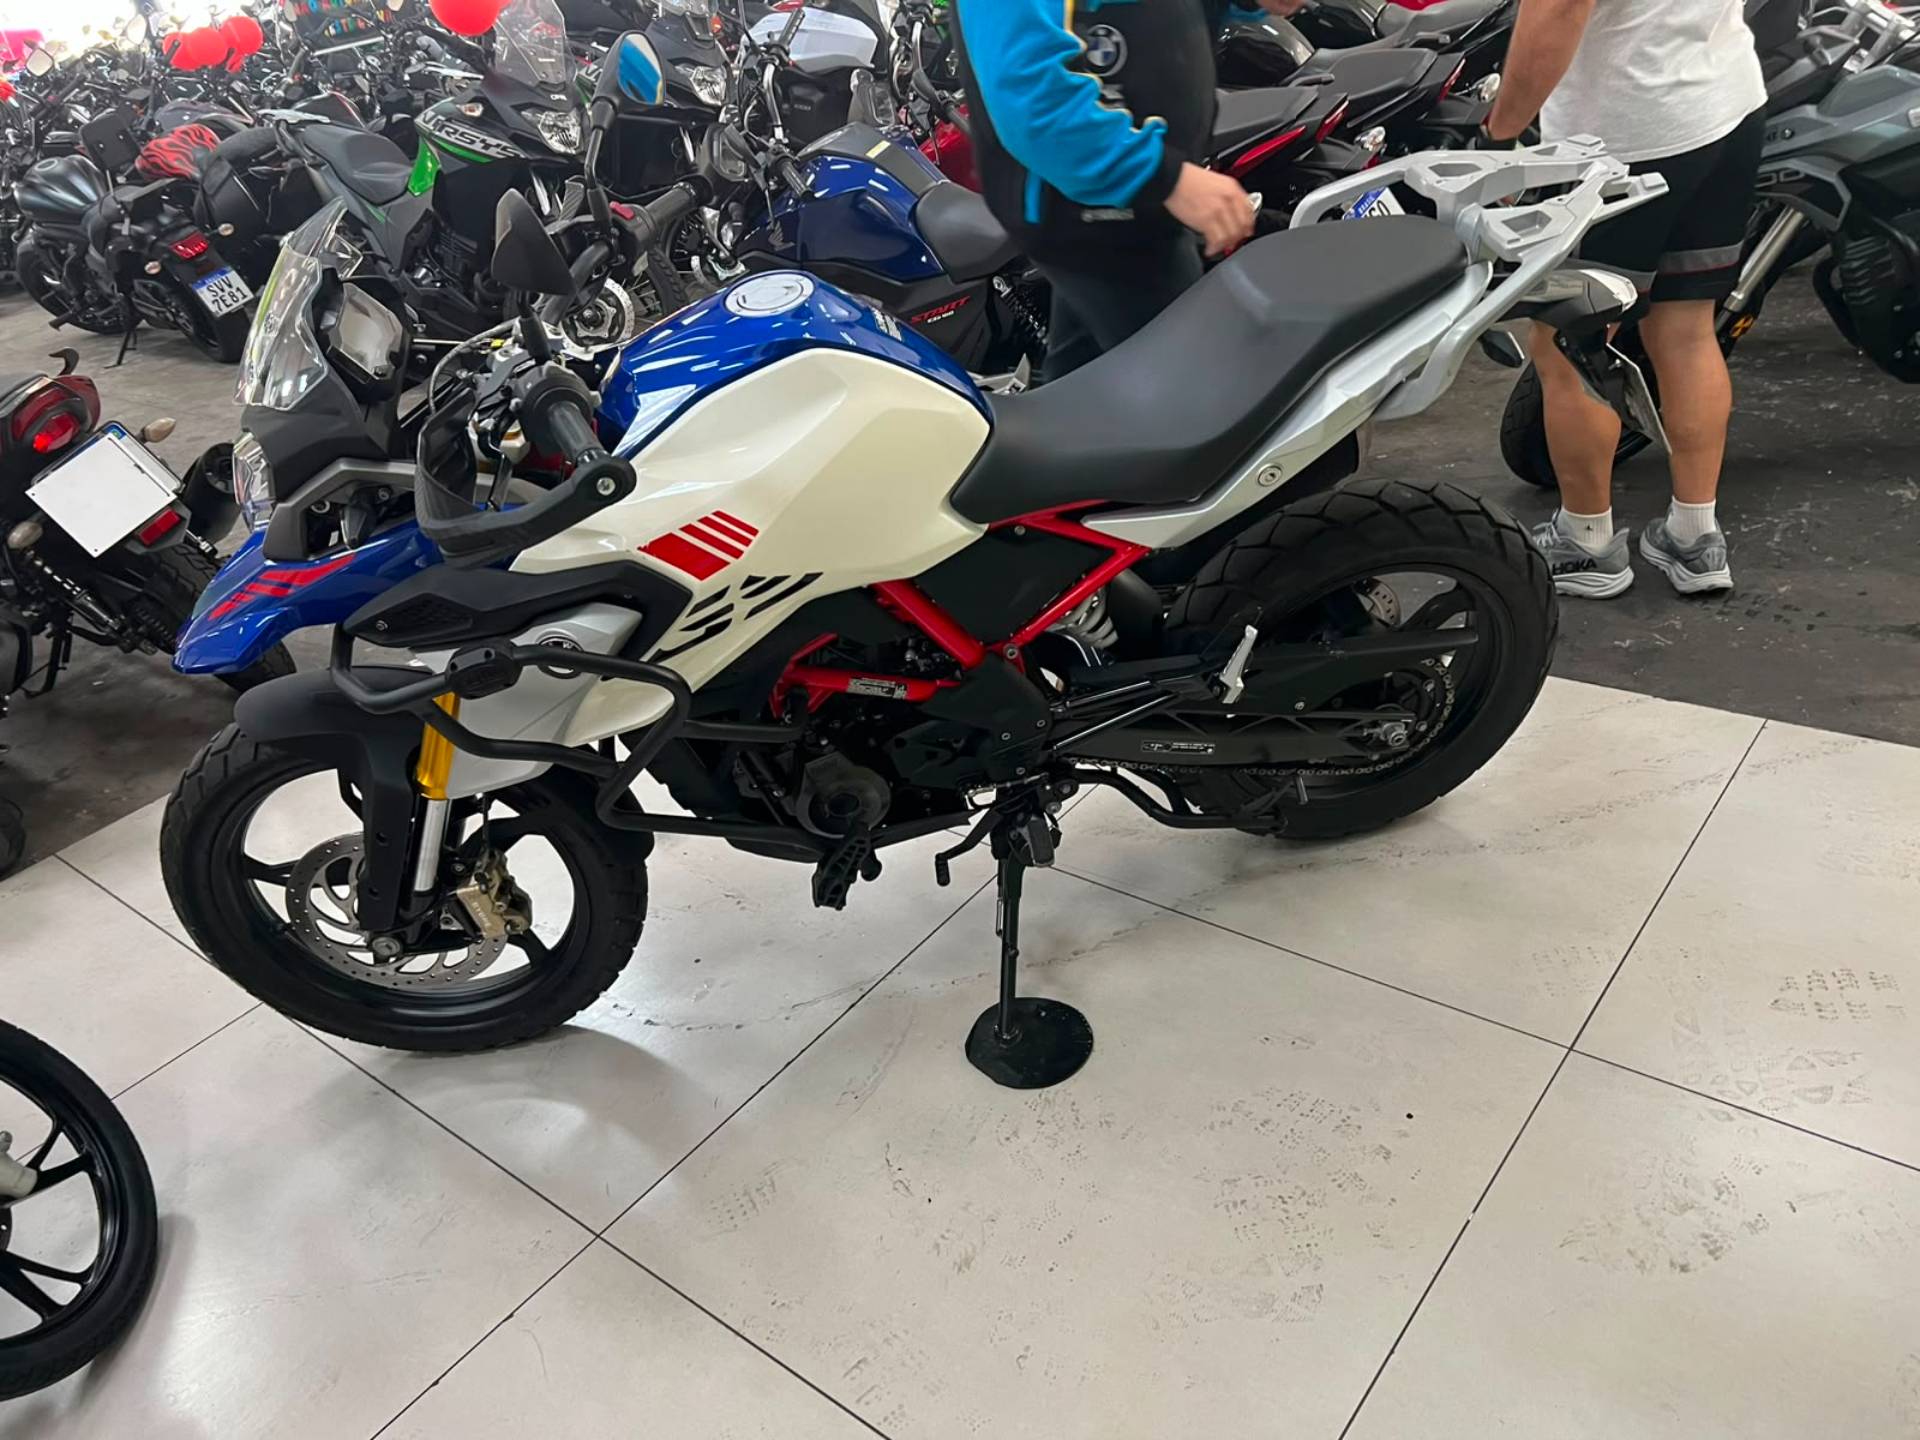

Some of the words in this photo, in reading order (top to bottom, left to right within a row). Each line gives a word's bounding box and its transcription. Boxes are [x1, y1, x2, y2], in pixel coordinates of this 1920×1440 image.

[207, 275, 233, 298] SVV
[212, 286, 248, 312] 7E81
[1551, 558, 1598, 576] HOKA
